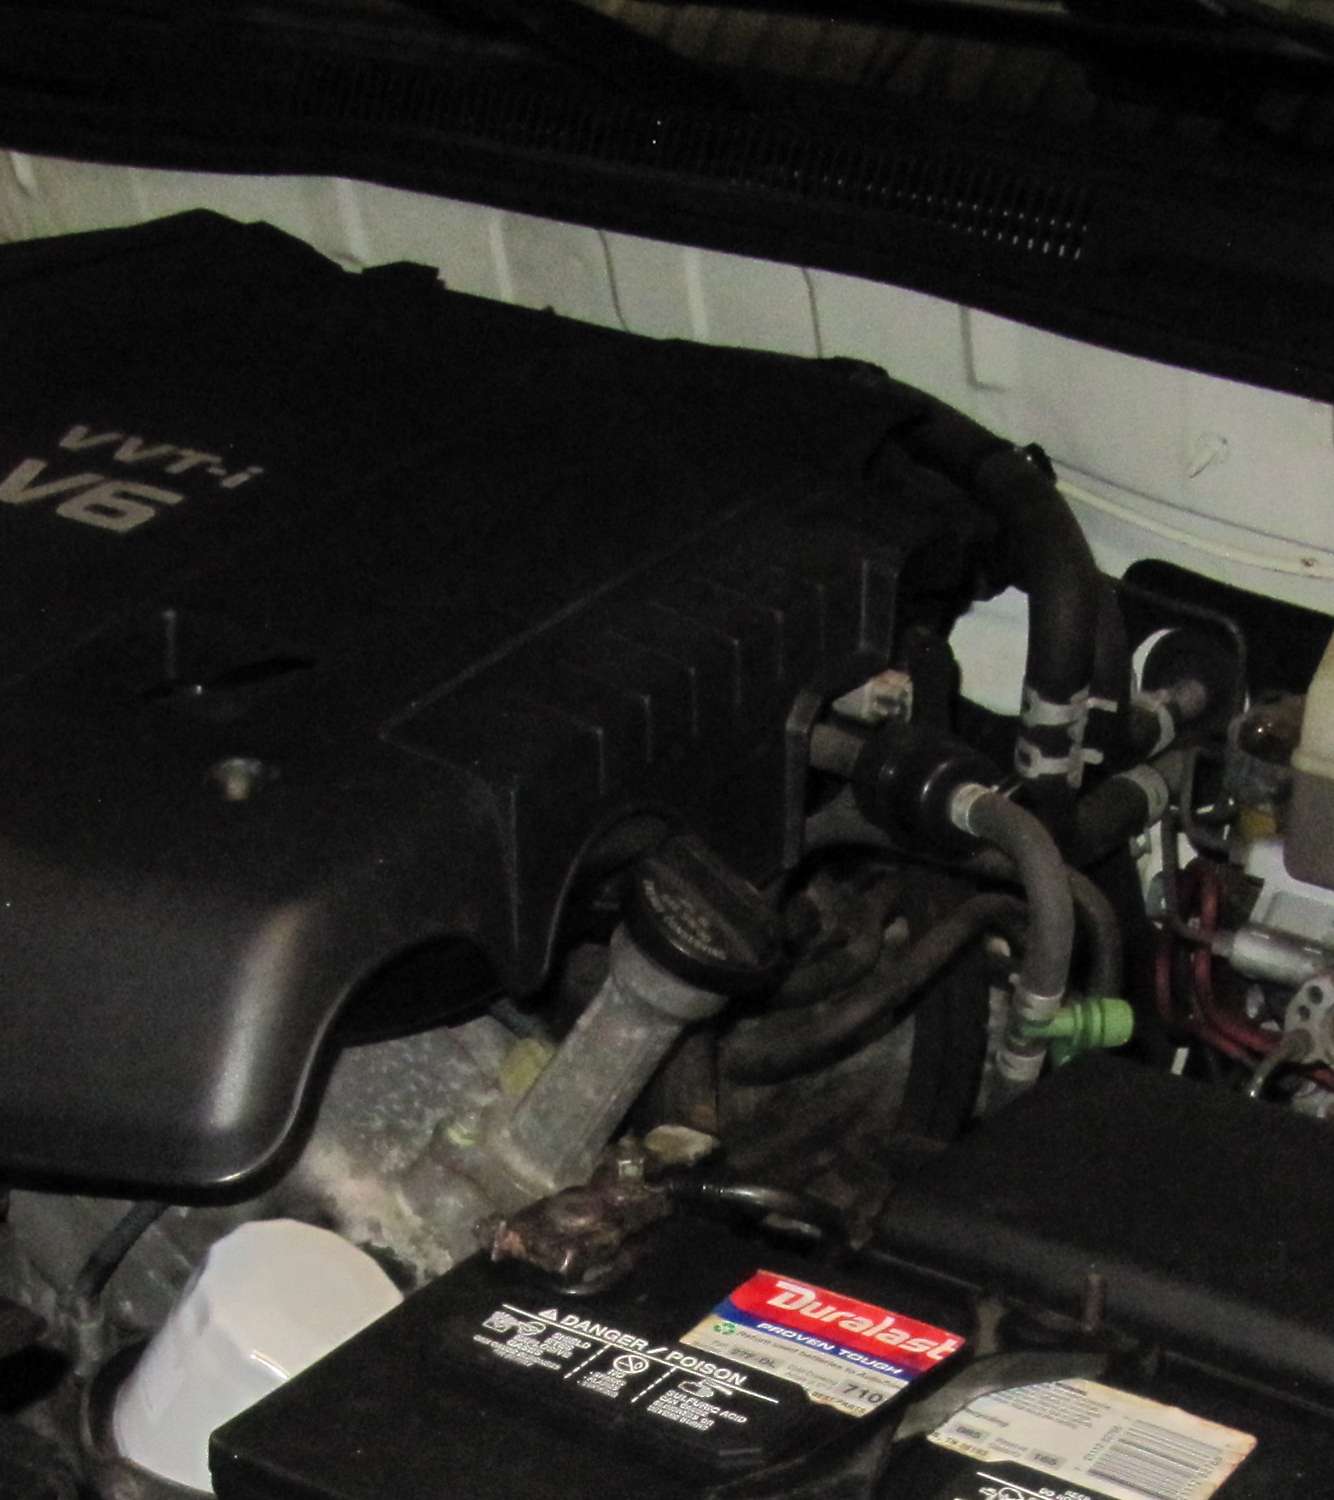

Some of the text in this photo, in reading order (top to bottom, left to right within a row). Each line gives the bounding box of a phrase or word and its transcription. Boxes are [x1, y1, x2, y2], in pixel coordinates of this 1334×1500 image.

[59, 425, 264, 488] VVT-i
[756, 1322, 835, 1351] PROVEN
[839, 1348, 903, 1376] TOUGH
[766, 1280, 957, 1360] Duralast
[560, 1313, 650, 1352] DANGER
[664, 1350, 749, 1387] POISON
[663, 1390, 749, 1423] SULFURIC ACID
[841, 1381, 883, 1404] 710
